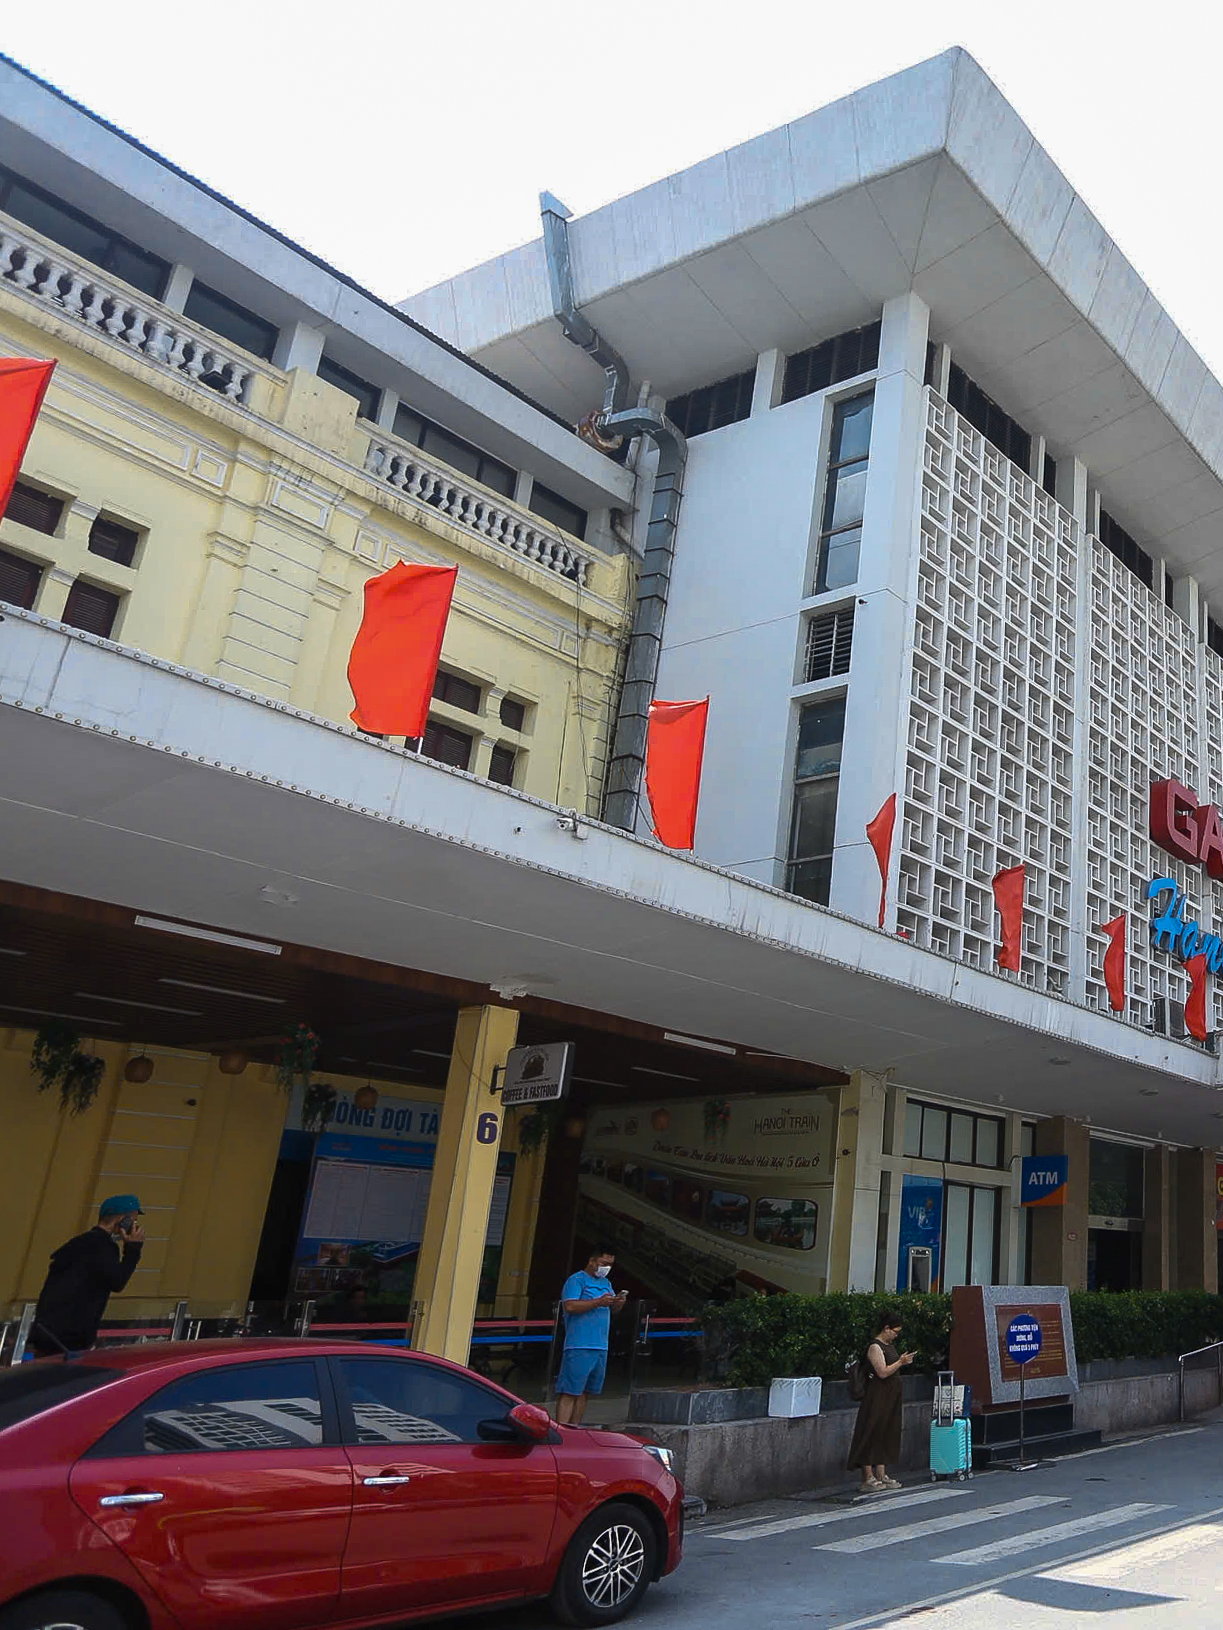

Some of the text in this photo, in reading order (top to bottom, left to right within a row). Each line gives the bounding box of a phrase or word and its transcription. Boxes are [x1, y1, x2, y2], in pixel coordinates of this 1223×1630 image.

[332, 1095, 375, 1128] ÒNG
[419, 1108, 438, 1135] TÀ
[754, 1115, 820, 1133] HANOI TRAIN
[476, 1112, 499, 1144] 6
[1028, 1172, 1058, 1185] ATM
